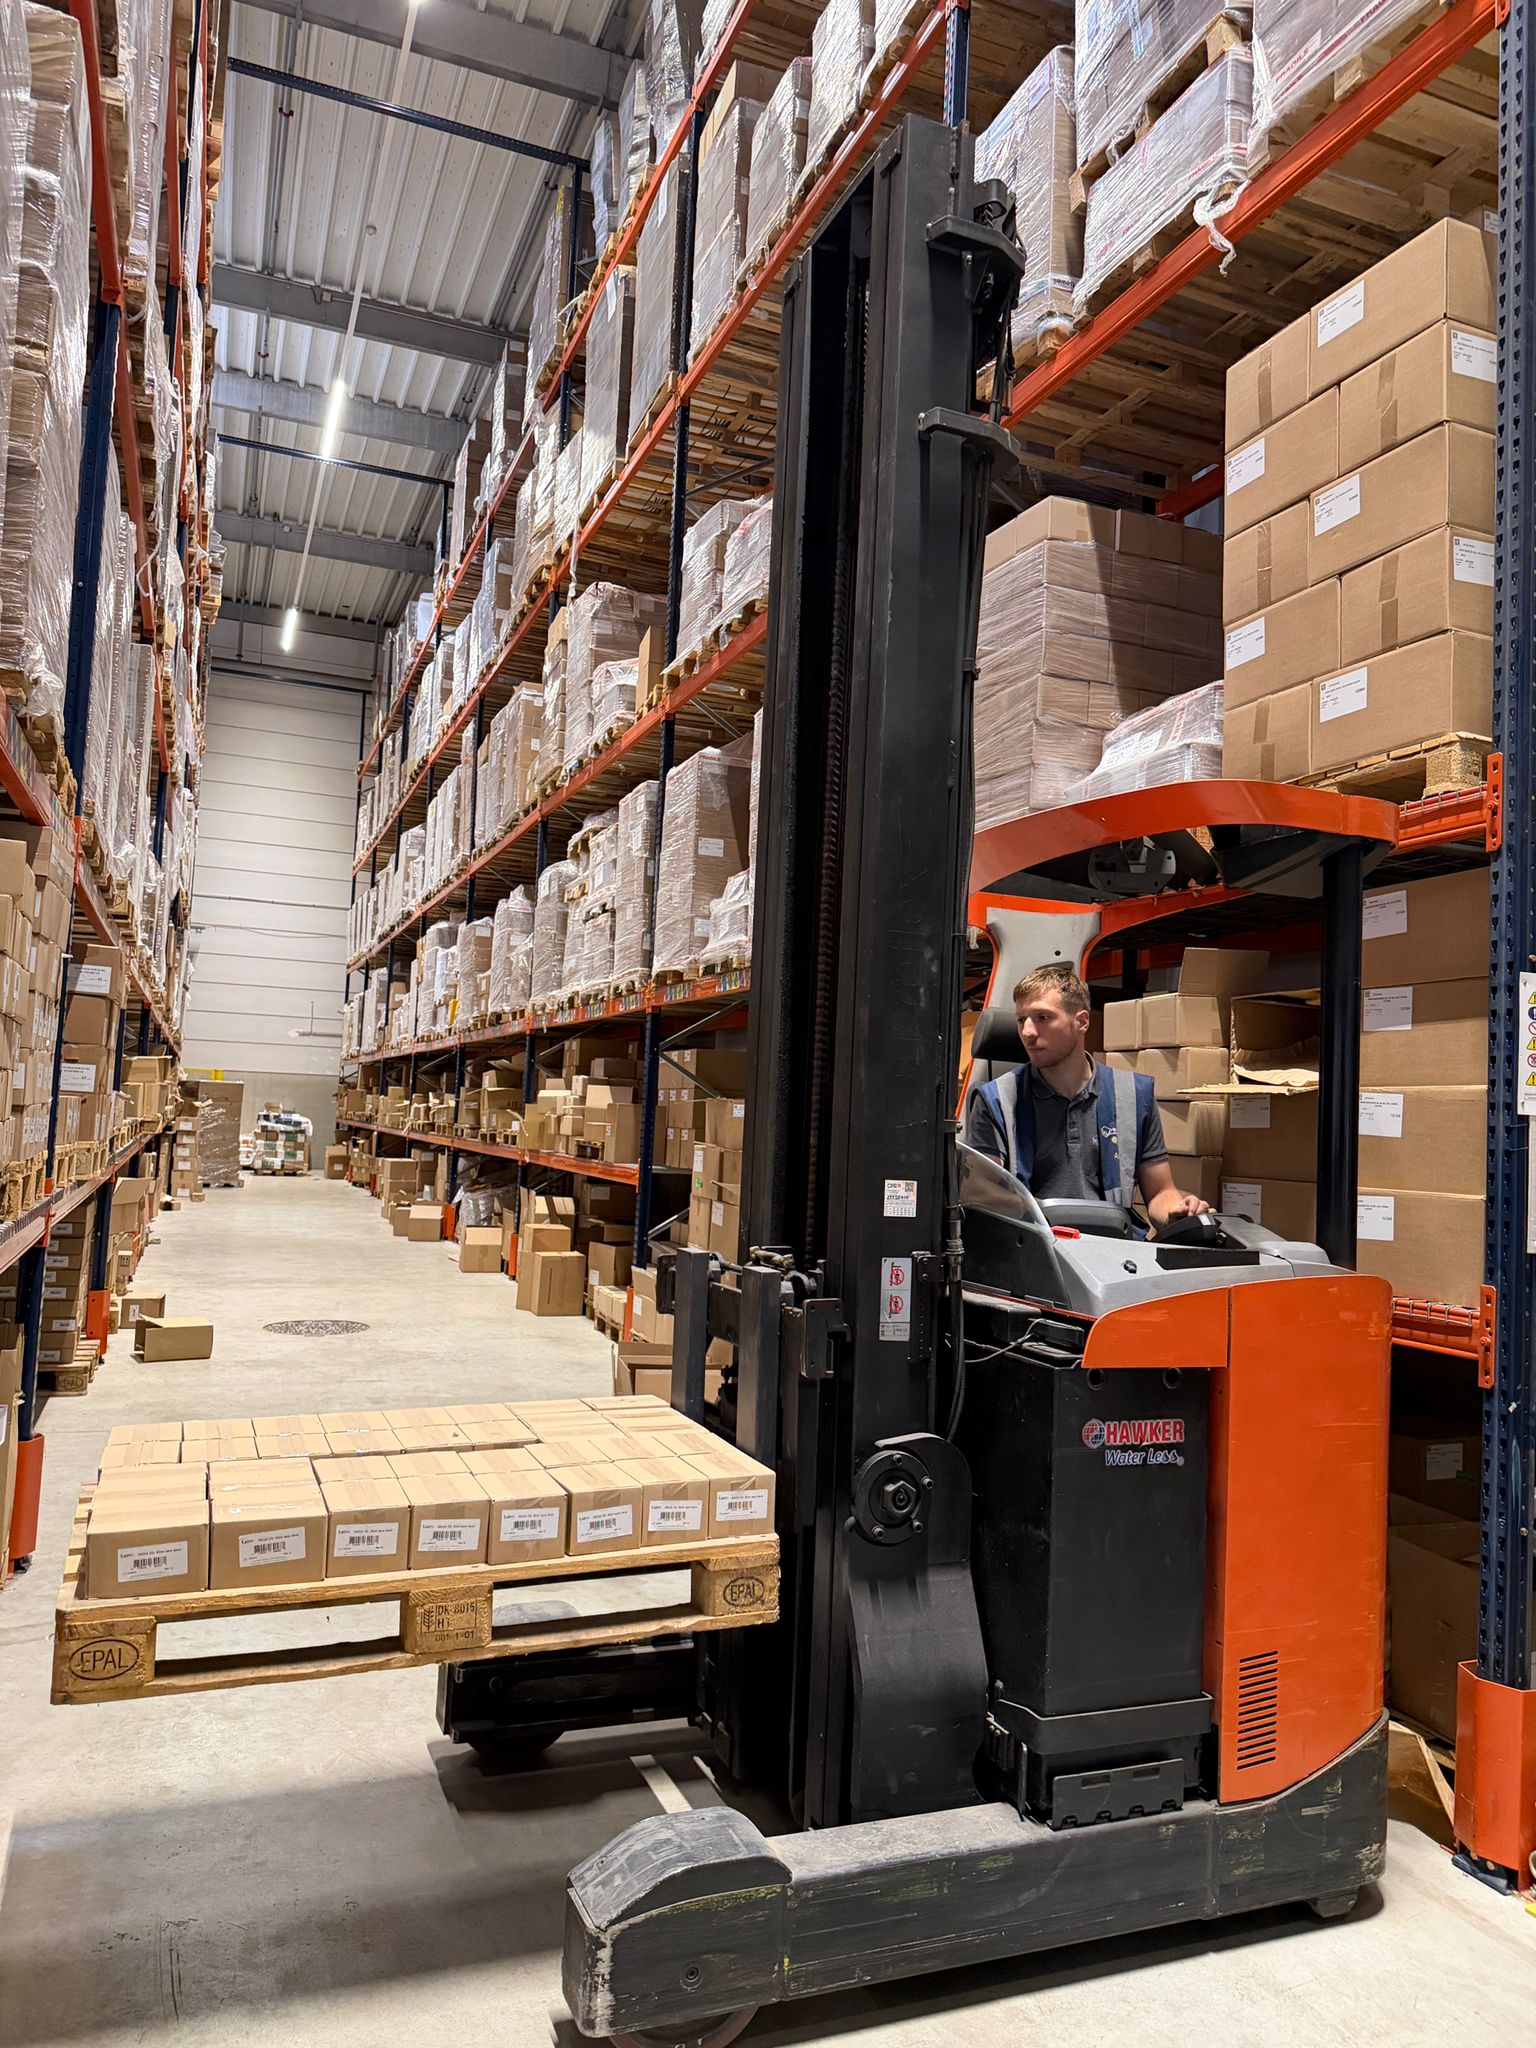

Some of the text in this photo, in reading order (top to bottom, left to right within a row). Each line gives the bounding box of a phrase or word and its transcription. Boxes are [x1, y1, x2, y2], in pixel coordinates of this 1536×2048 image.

[1104, 1418, 1185, 1446] HAWKER
[1104, 1449, 1146, 1467] Water
[80, 1647, 129, 1673] EPAL
